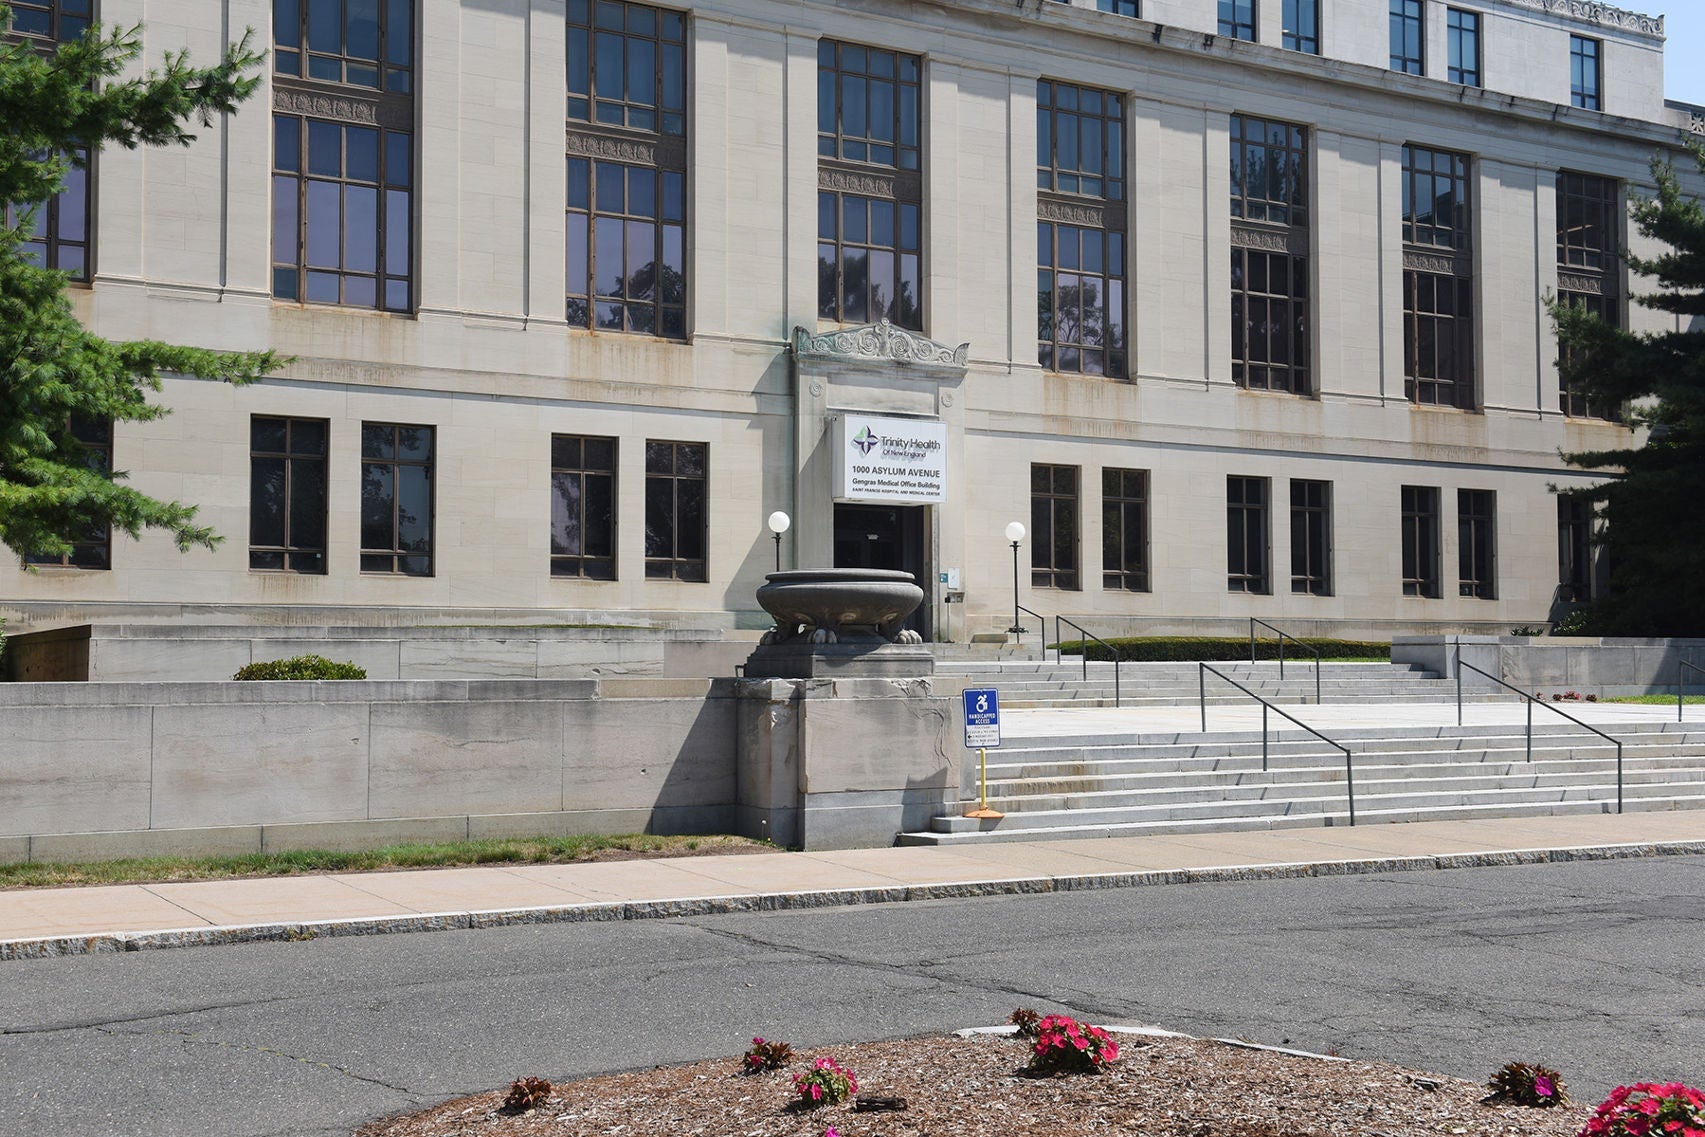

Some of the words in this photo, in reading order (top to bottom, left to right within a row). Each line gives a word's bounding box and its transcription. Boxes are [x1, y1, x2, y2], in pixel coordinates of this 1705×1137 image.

[881, 436, 909, 449] Trinity
[910, 438, 940, 450] Health
[903, 450, 926, 459] England
[852, 465, 870, 474] 1000
[872, 466, 906, 476] ASYLUM
[908, 468, 940, 478] AVENUE
[852, 478, 876, 486] Gengras
[877, 479, 899, 487] Medical
[900, 480, 916, 488] Office
[917, 481, 940, 490] Building
